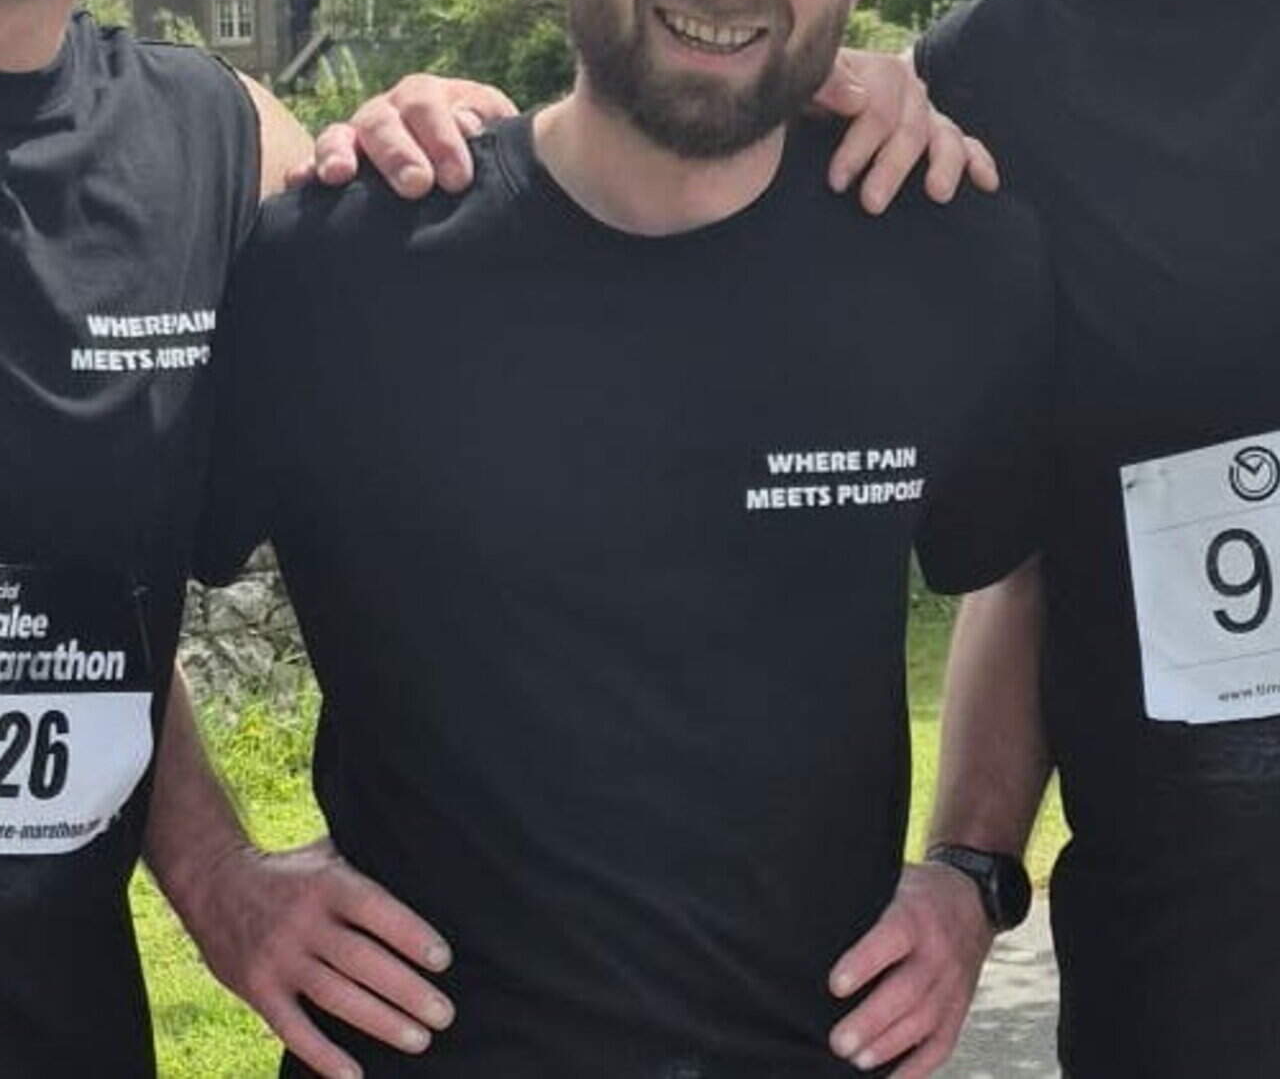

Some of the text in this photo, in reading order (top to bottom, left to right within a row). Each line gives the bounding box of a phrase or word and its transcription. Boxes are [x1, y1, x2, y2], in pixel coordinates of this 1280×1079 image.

[71, 347, 154, 371] MEETS
[767, 446, 917, 475] WHERE PAIN
[746, 485, 831, 510] MEETS
